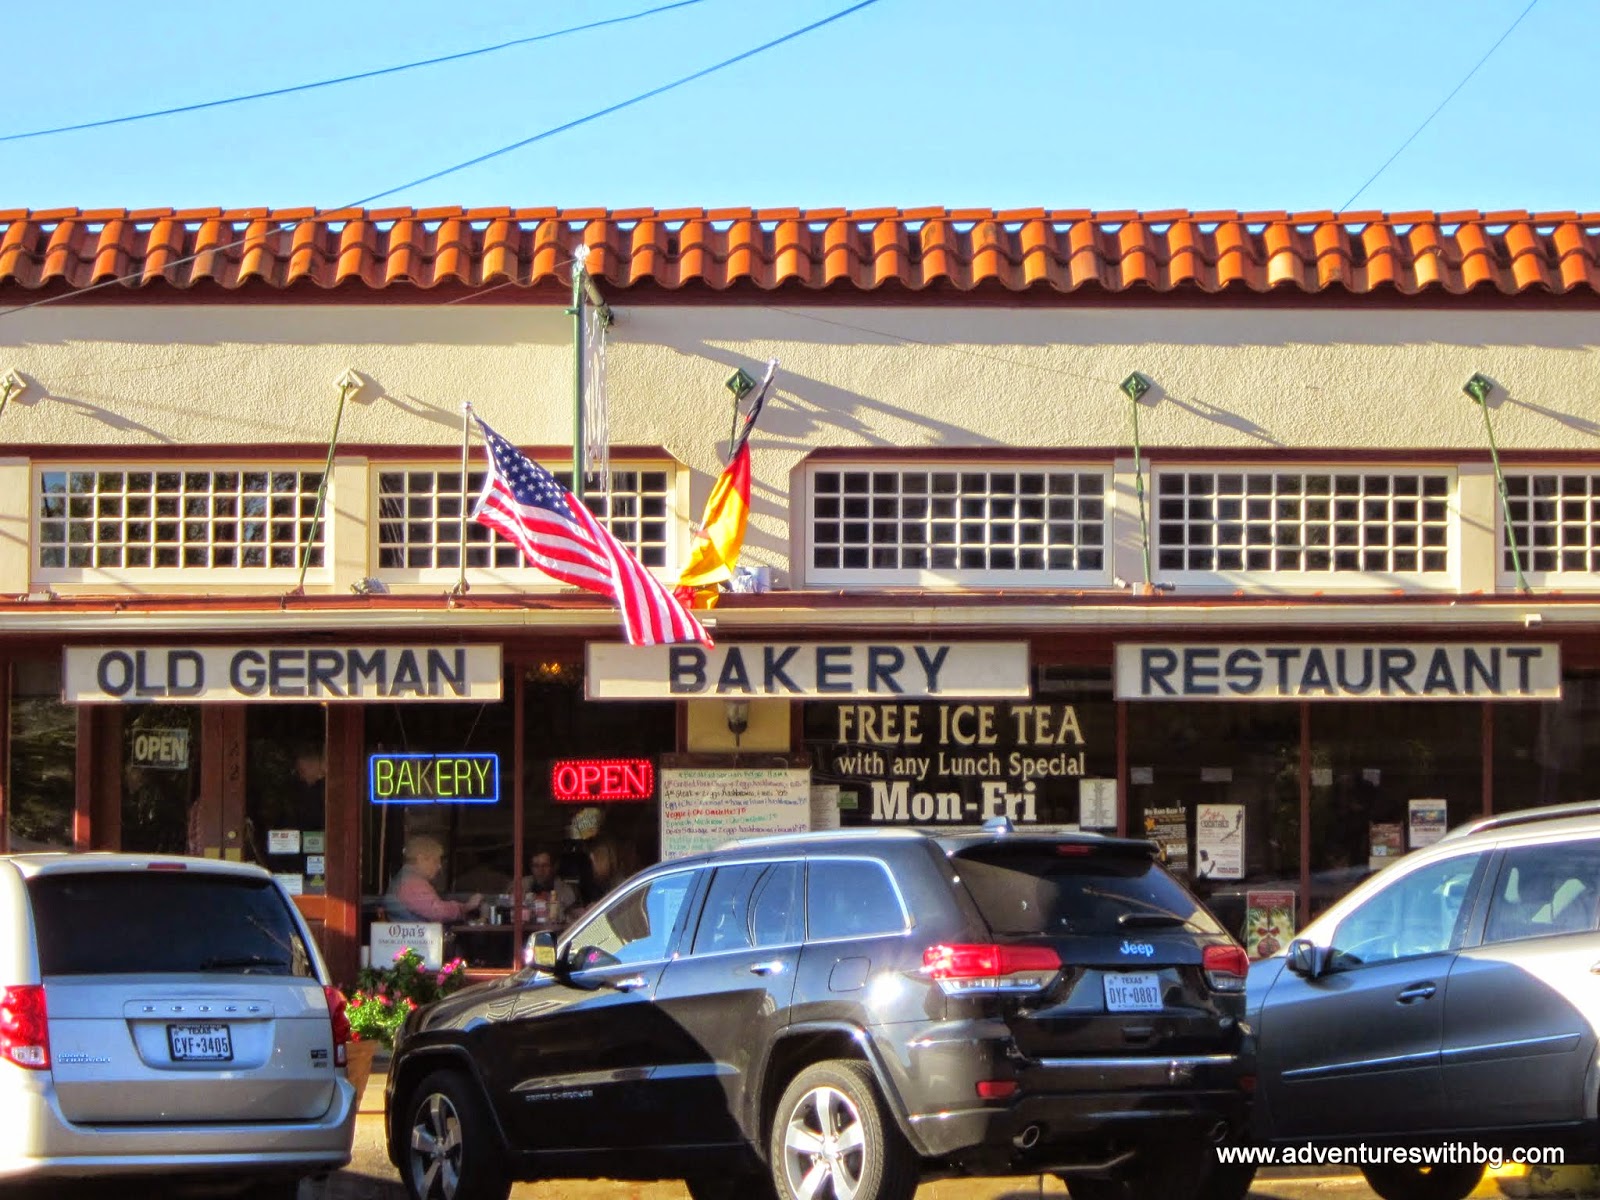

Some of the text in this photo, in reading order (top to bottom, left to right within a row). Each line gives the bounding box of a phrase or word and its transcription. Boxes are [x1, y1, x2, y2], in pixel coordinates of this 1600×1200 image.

[97, 649, 466, 697] OLD GERMAN
[669, 646, 950, 694] BAKERY
[1140, 647, 1542, 695] RESTAURANT
[838, 705, 1085, 744] FREE ICE TEA
[135, 735, 184, 760] OPEN
[376, 759, 490, 796] BAKERY
[557, 765, 648, 795] OPEN
[839, 752, 1085, 780] with any Lunch Special
[871, 781, 1037, 820] Mon-Fri
[389, 924, 425, 938] Opa's
[1120, 940, 1154, 957] Jeep
[1122, 976, 1143, 984] TEXAS
[188, 1026, 212, 1035] TEXAS
